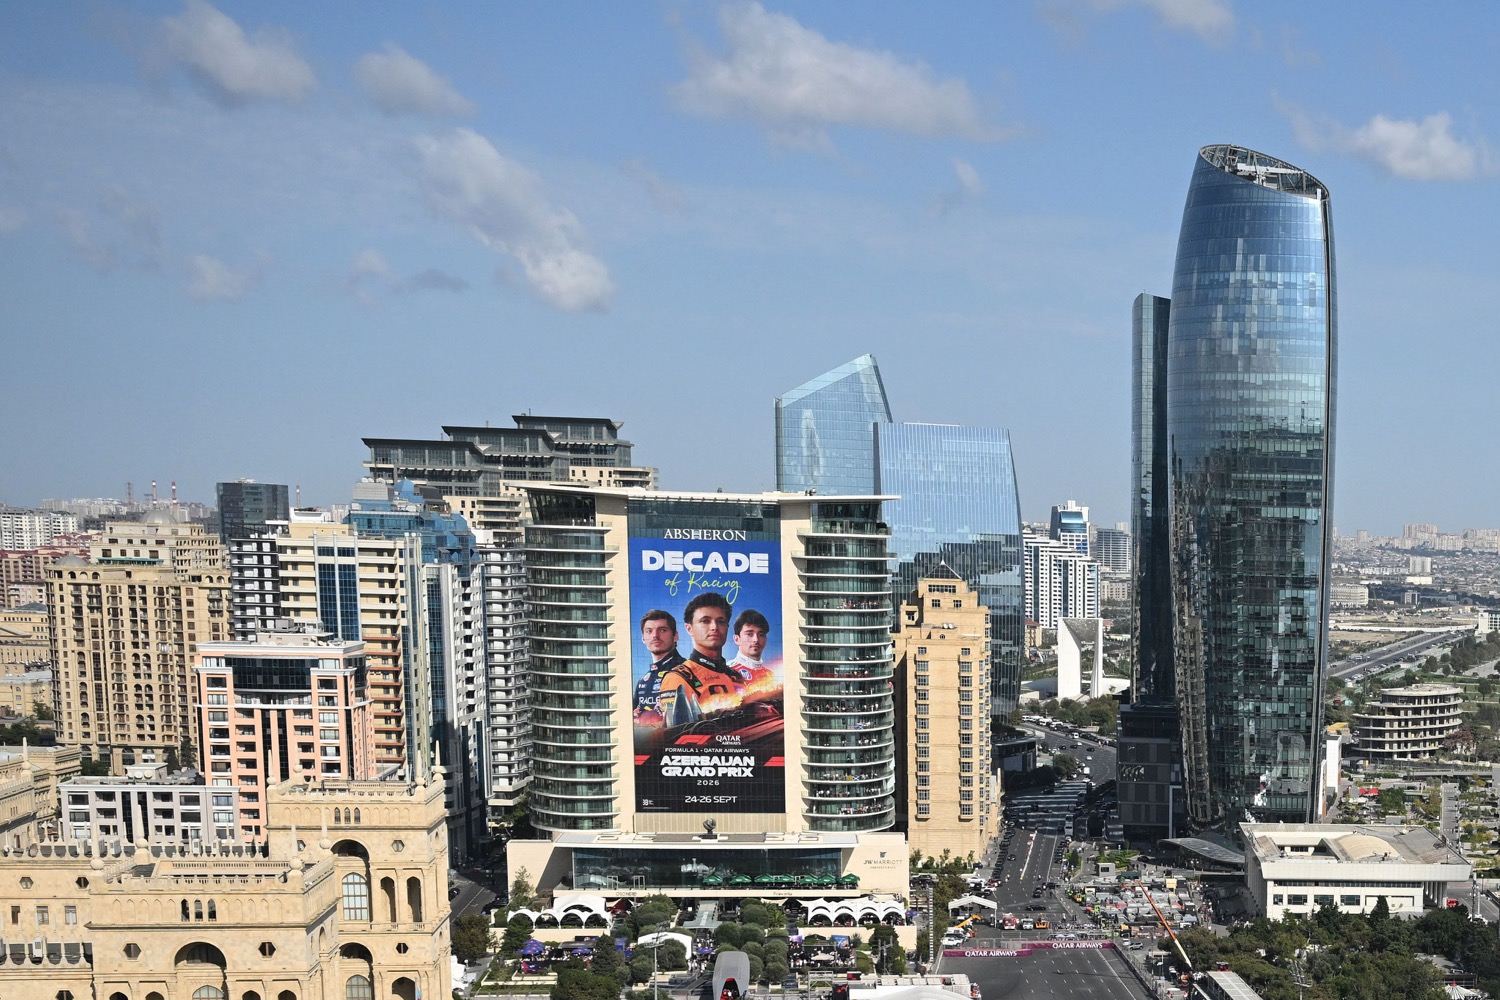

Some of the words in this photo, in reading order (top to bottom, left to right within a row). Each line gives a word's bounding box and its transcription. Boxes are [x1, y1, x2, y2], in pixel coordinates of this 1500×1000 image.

[664, 529, 746, 541] ABSHERON
[642, 550, 769, 574] DECADE
[665, 573, 681, 596] of
[688, 569, 742, 605] Racing
[660, 756, 755, 766] AZERBAIJAN
[661, 767, 716, 777] GRAND
[718, 767, 754, 777] PRIX
[685, 795, 712, 803] 24-26
[713, 795, 738, 803] SEPT
